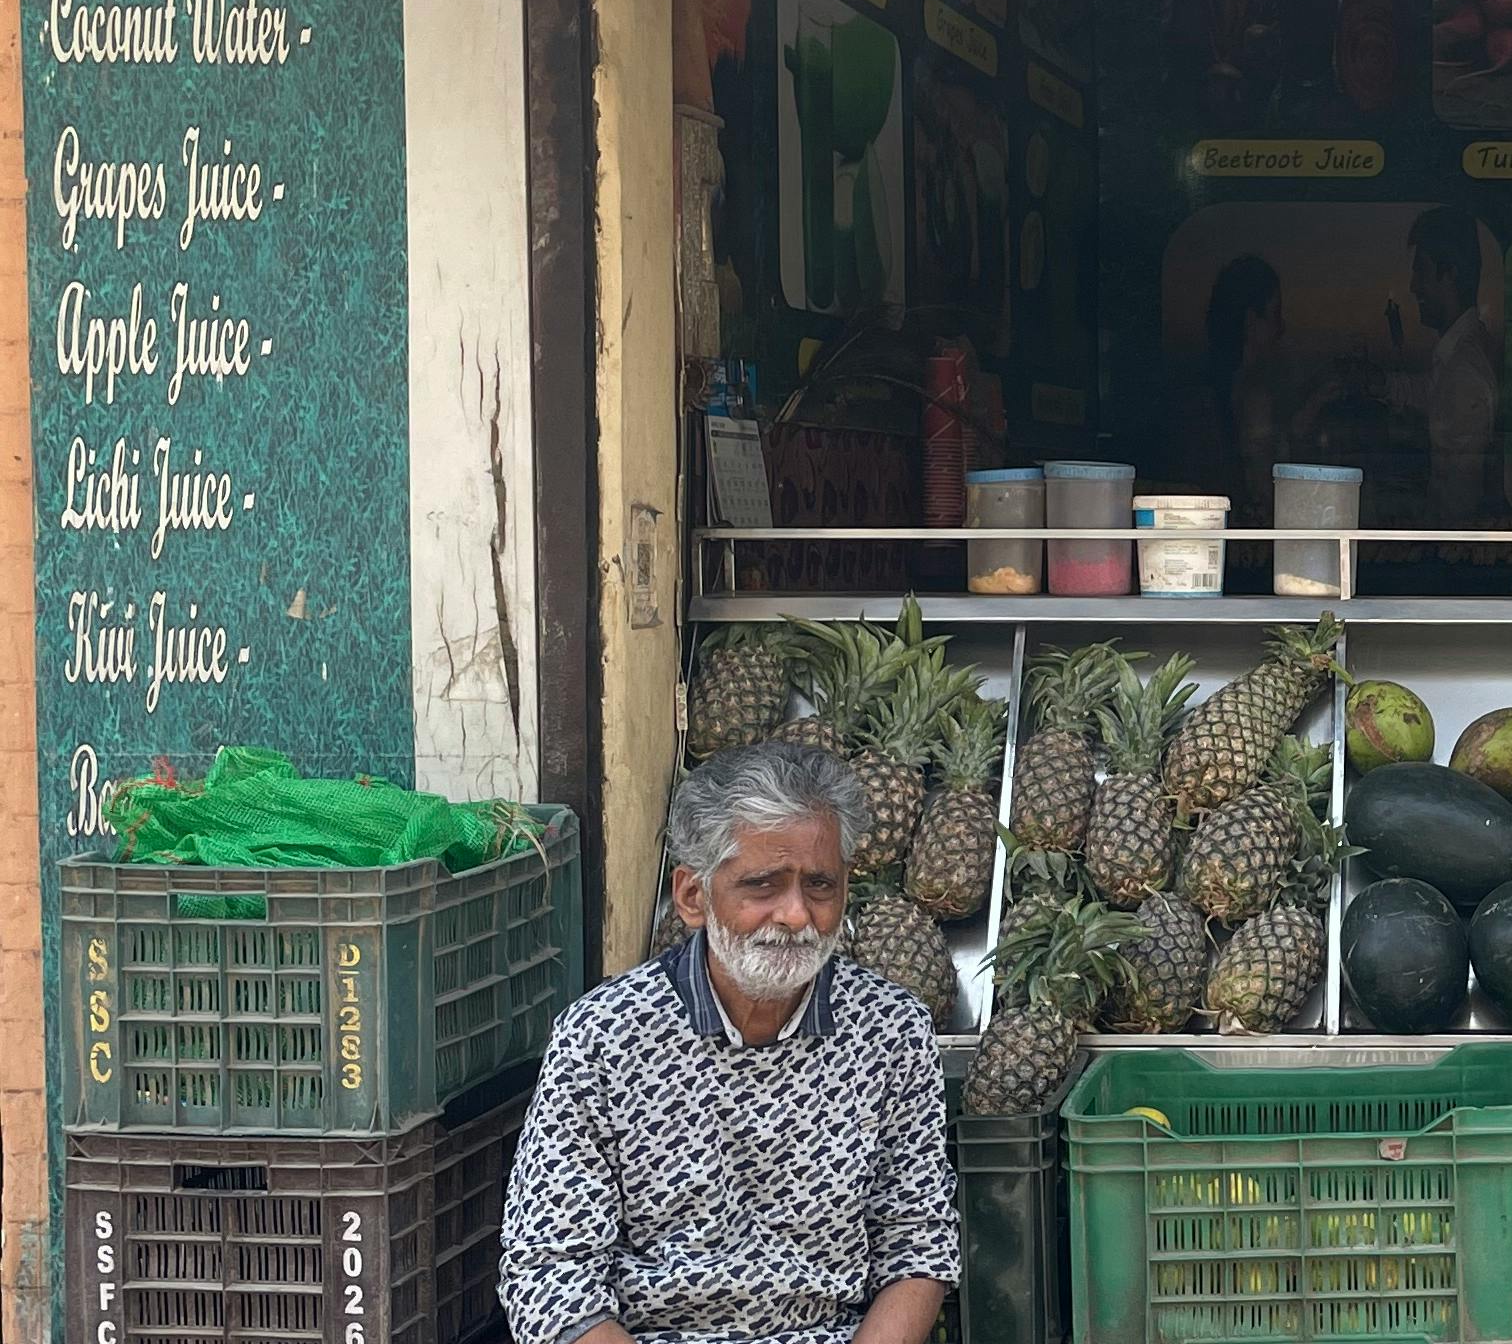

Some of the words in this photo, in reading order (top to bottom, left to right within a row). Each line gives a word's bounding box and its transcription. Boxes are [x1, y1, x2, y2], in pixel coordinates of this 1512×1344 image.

[54, 126, 167, 251] Grapes
[180, 127, 262, 251] Juice
[1203, 147, 1303, 171] Beetroot
[1315, 146, 1375, 171] Juice
[57, 281, 158, 404] Apple
[168, 282, 251, 406] Juice
[61, 436, 142, 531] Lichi
[151, 437, 234, 560] Juice
[65, 591, 137, 683] Kiwi
[147, 592, 228, 713] Juice
